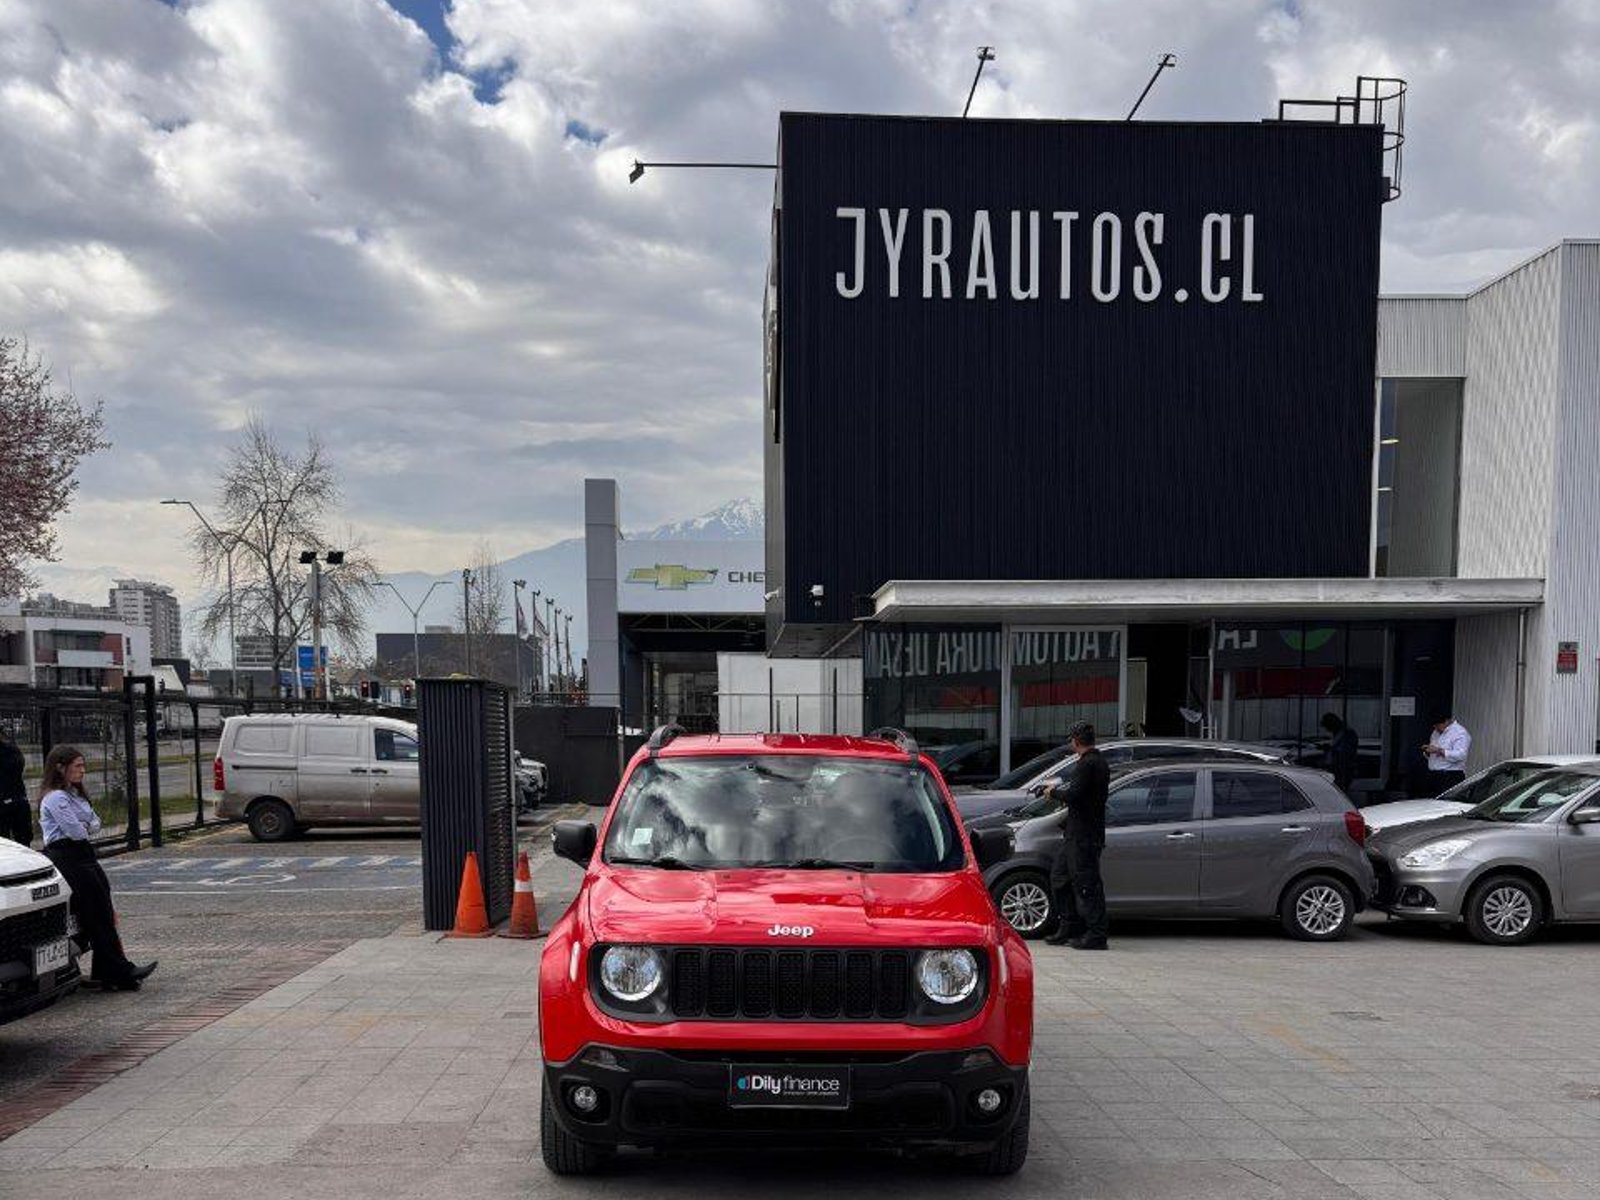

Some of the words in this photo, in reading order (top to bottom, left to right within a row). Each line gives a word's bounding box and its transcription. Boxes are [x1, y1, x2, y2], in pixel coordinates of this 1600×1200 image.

[836, 207, 1264, 303] JYRAUTOS.CL
[767, 924, 814, 938] Jeep
[751, 1076, 781, 1095] Dily
[783, 1075, 840, 1091] finance
